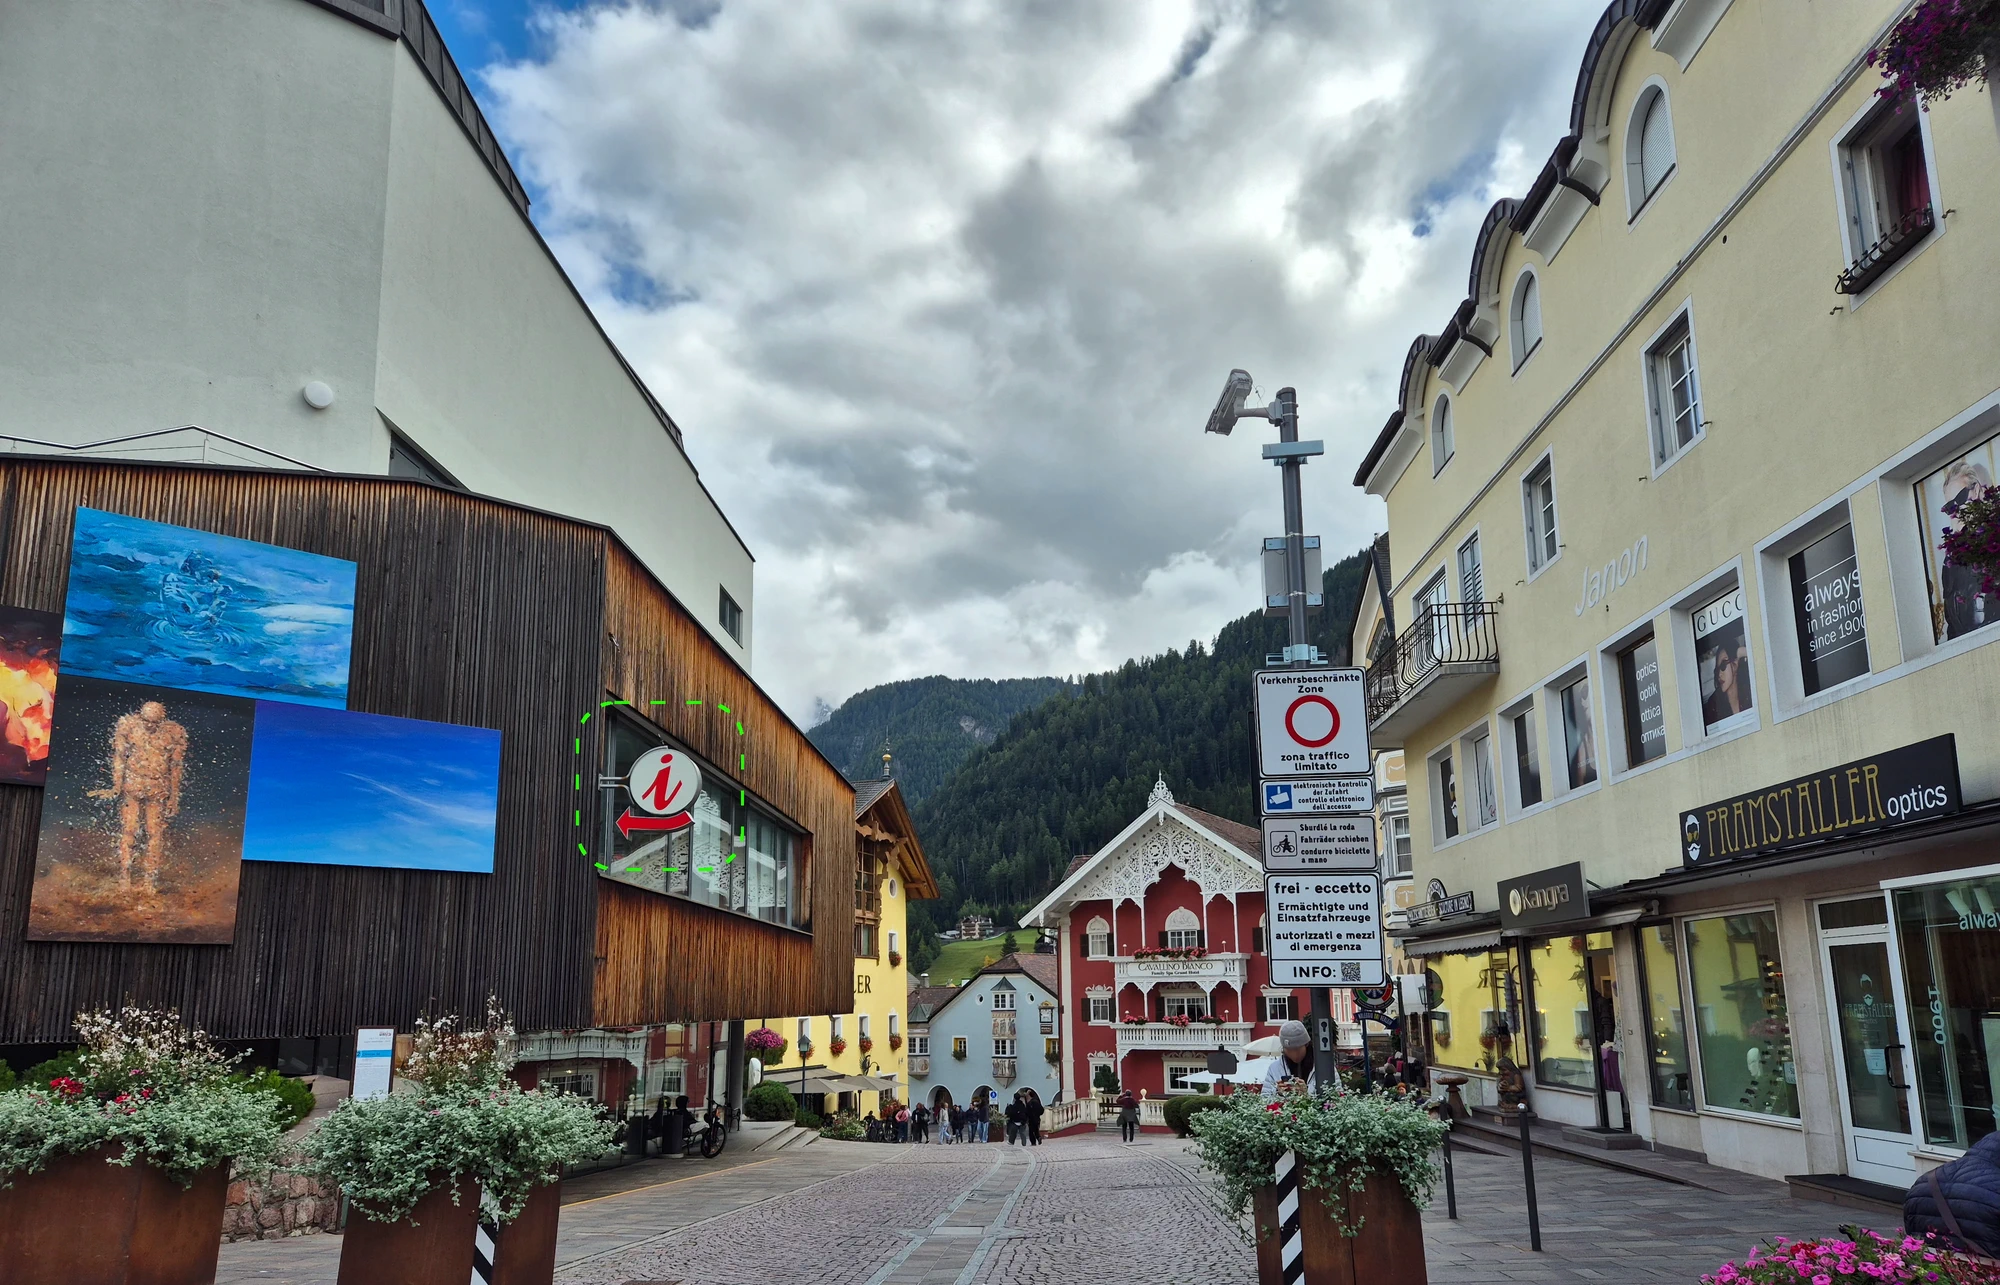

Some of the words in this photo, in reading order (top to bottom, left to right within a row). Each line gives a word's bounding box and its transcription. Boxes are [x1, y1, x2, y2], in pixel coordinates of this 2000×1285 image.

[1574, 534, 1648, 616] Janon
[1804, 568, 1860, 612] always
[1806, 618, 1818, 634] in
[1810, 630, 1836, 652] since
[1636, 661, 1658, 682] optics
[1260, 673, 1360, 685] Verkehrsbeschränkte
[1298, 685, 1324, 694] Zone
[1640, 682, 1658, 702] optik
[1640, 704, 1661, 723] ottica
[1280, 753, 1305, 762] zona
[1309, 751, 1350, 760] traffico
[1294, 762, 1338, 771] limitato
[1706, 764, 1886, 857] PRAMSTALLER
[1887, 785, 1948, 820] optics
[1300, 824, 1328, 832] Sburdlé
[1274, 882, 1300, 894] frei
[1314, 882, 1372, 894] eccetto
[1521, 883, 1570, 912] Kangra
[1278, 902, 1345, 912] Ermächtigte
[1348, 902, 1369, 910] und
[1277, 914, 1371, 924] Einsatzfahrzeuge
[1276, 930, 1333, 940] autorizzati
[1346, 930, 1376, 940] mezzi
[1290, 942, 1300, 951] di
[1304, 944, 1362, 952] emergenza
[1138, 962, 1180, 971] CAVALLINO
[1293, 966, 1336, 978] INFO:
[854, 974, 872, 994] ER
[1927, 985, 1947, 1045] 1900
